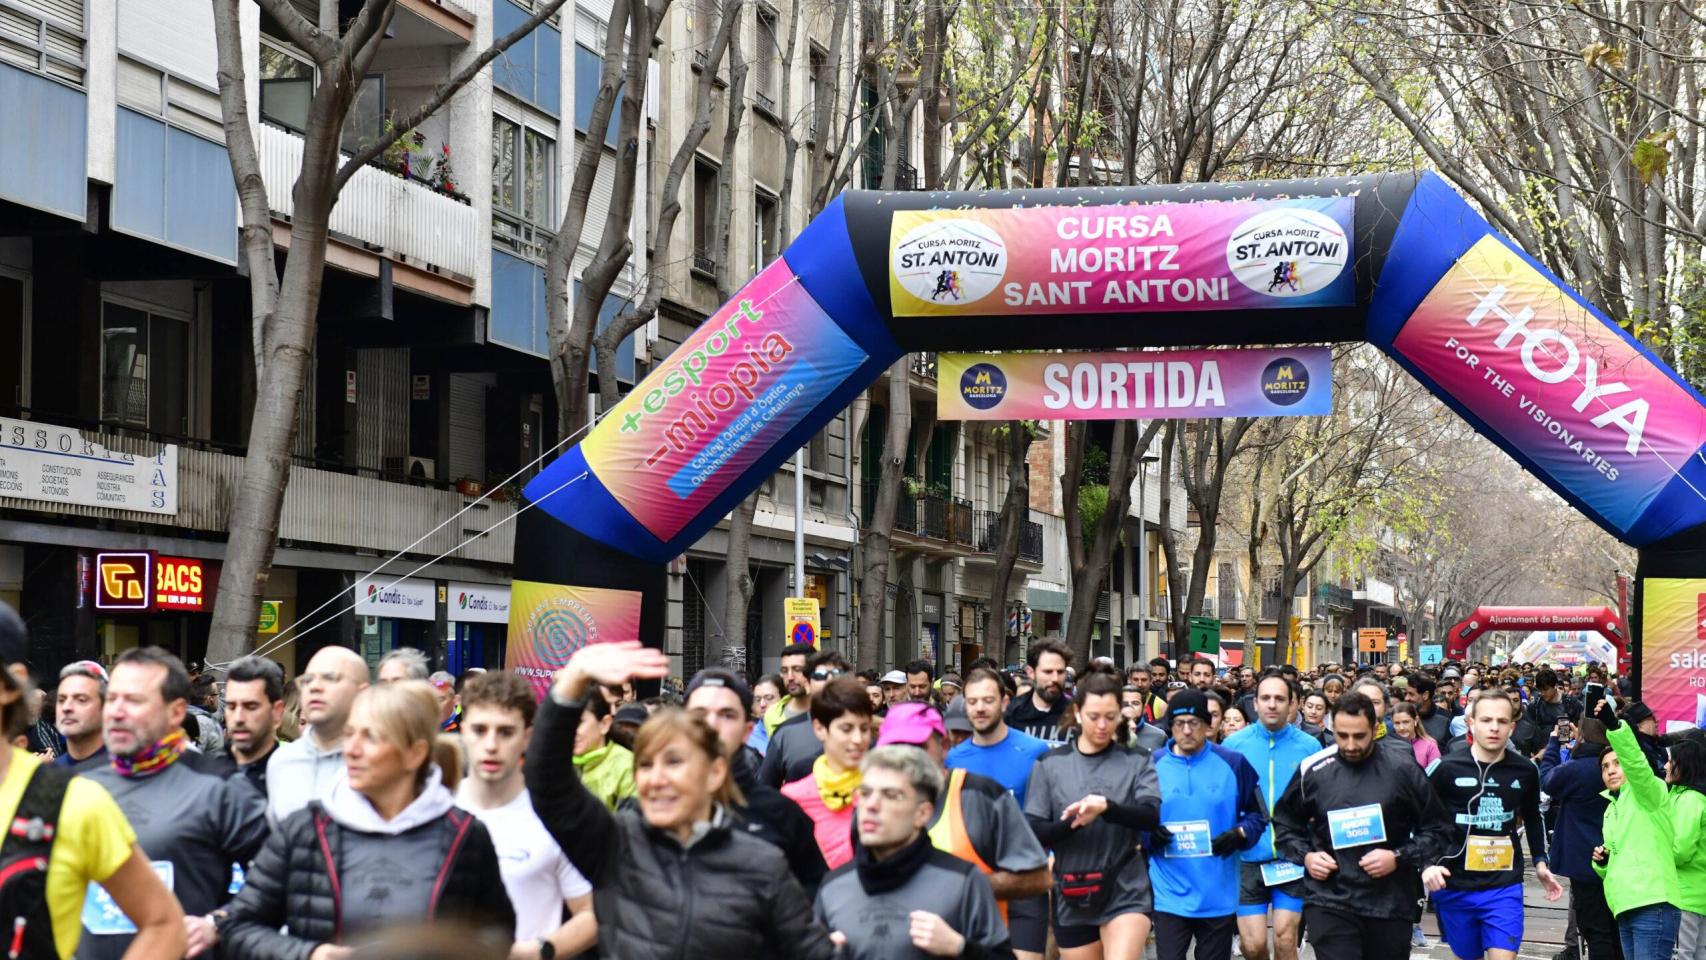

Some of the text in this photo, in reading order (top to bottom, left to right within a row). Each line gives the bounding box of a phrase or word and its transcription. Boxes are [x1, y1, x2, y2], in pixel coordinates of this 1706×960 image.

[1056, 214, 1175, 240] CURSA
[1253, 228, 1320, 241] CURSA MORITZ
[918, 238, 982, 250] CURSA MORITZ
[1236, 240, 1340, 260] ST. ANTONI
[901, 250, 999, 269] ST. ANTONI
[1050, 245, 1180, 273] MORITZ
[1003, 277, 1230, 306] SANT ANTONI
[1465, 283, 1650, 458] HOYA
[964, 386, 1003, 394] MORITZ
[1043, 360, 1226, 410] SORTIDA
[1264, 381, 1306, 390] MORITZ
[1444, 336, 1621, 482] FOR THE VISIONARIES
[691, 383, 805, 486] Optometristes de Catalunya
[723, 413, 752, 441] Oficial
[41, 463, 82, 477] CONSTITUCIONS
[97, 471, 135, 484] ASSEGURANCES
[41, 474, 69, 486] SOCIETATS
[379, 587, 401, 604] Condis
[469, 594, 488, 610] Condis
[1489, 615, 1538, 625] Ajuntament
[1552, 616, 1595, 624] Barcelona
[1201, 633, 1208, 649] 2
[1369, 639, 1376, 649] 3
[1428, 653, 1435, 663] 4
